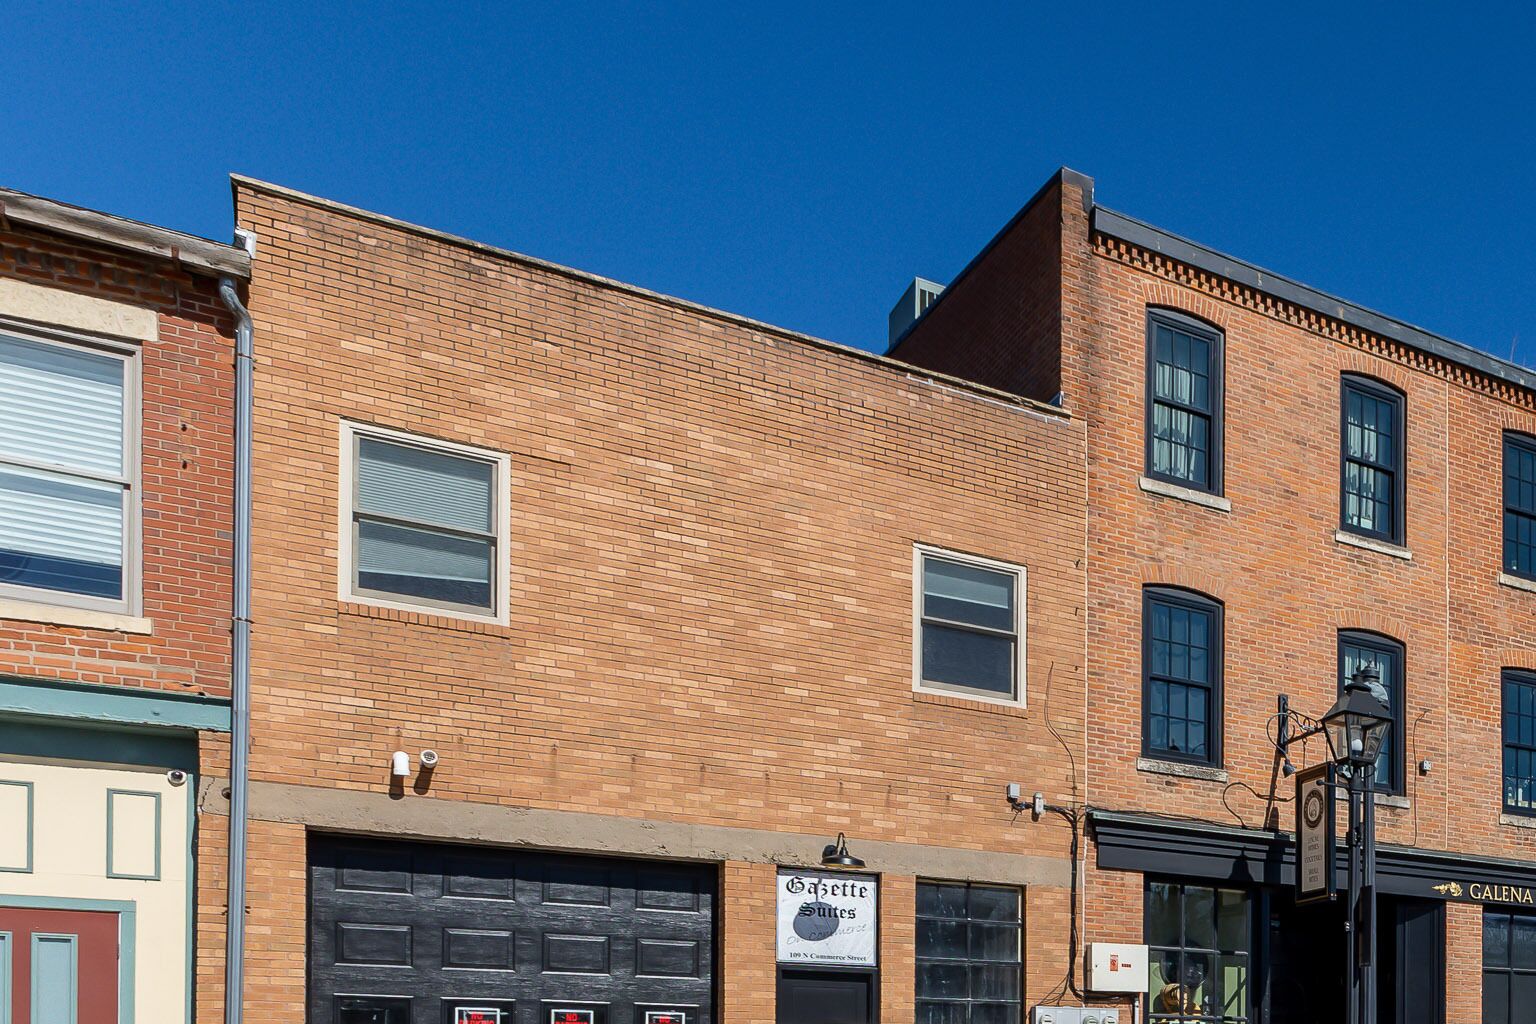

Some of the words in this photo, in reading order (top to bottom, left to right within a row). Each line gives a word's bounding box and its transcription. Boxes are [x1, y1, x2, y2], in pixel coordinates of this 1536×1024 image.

[786, 876, 868, 898] Gazette
[1469, 884, 1533, 904] GALENA
[799, 902, 857, 919] Suites
[470, 1011, 484, 1020] NO
[565, 1014, 578, 1022] NO
